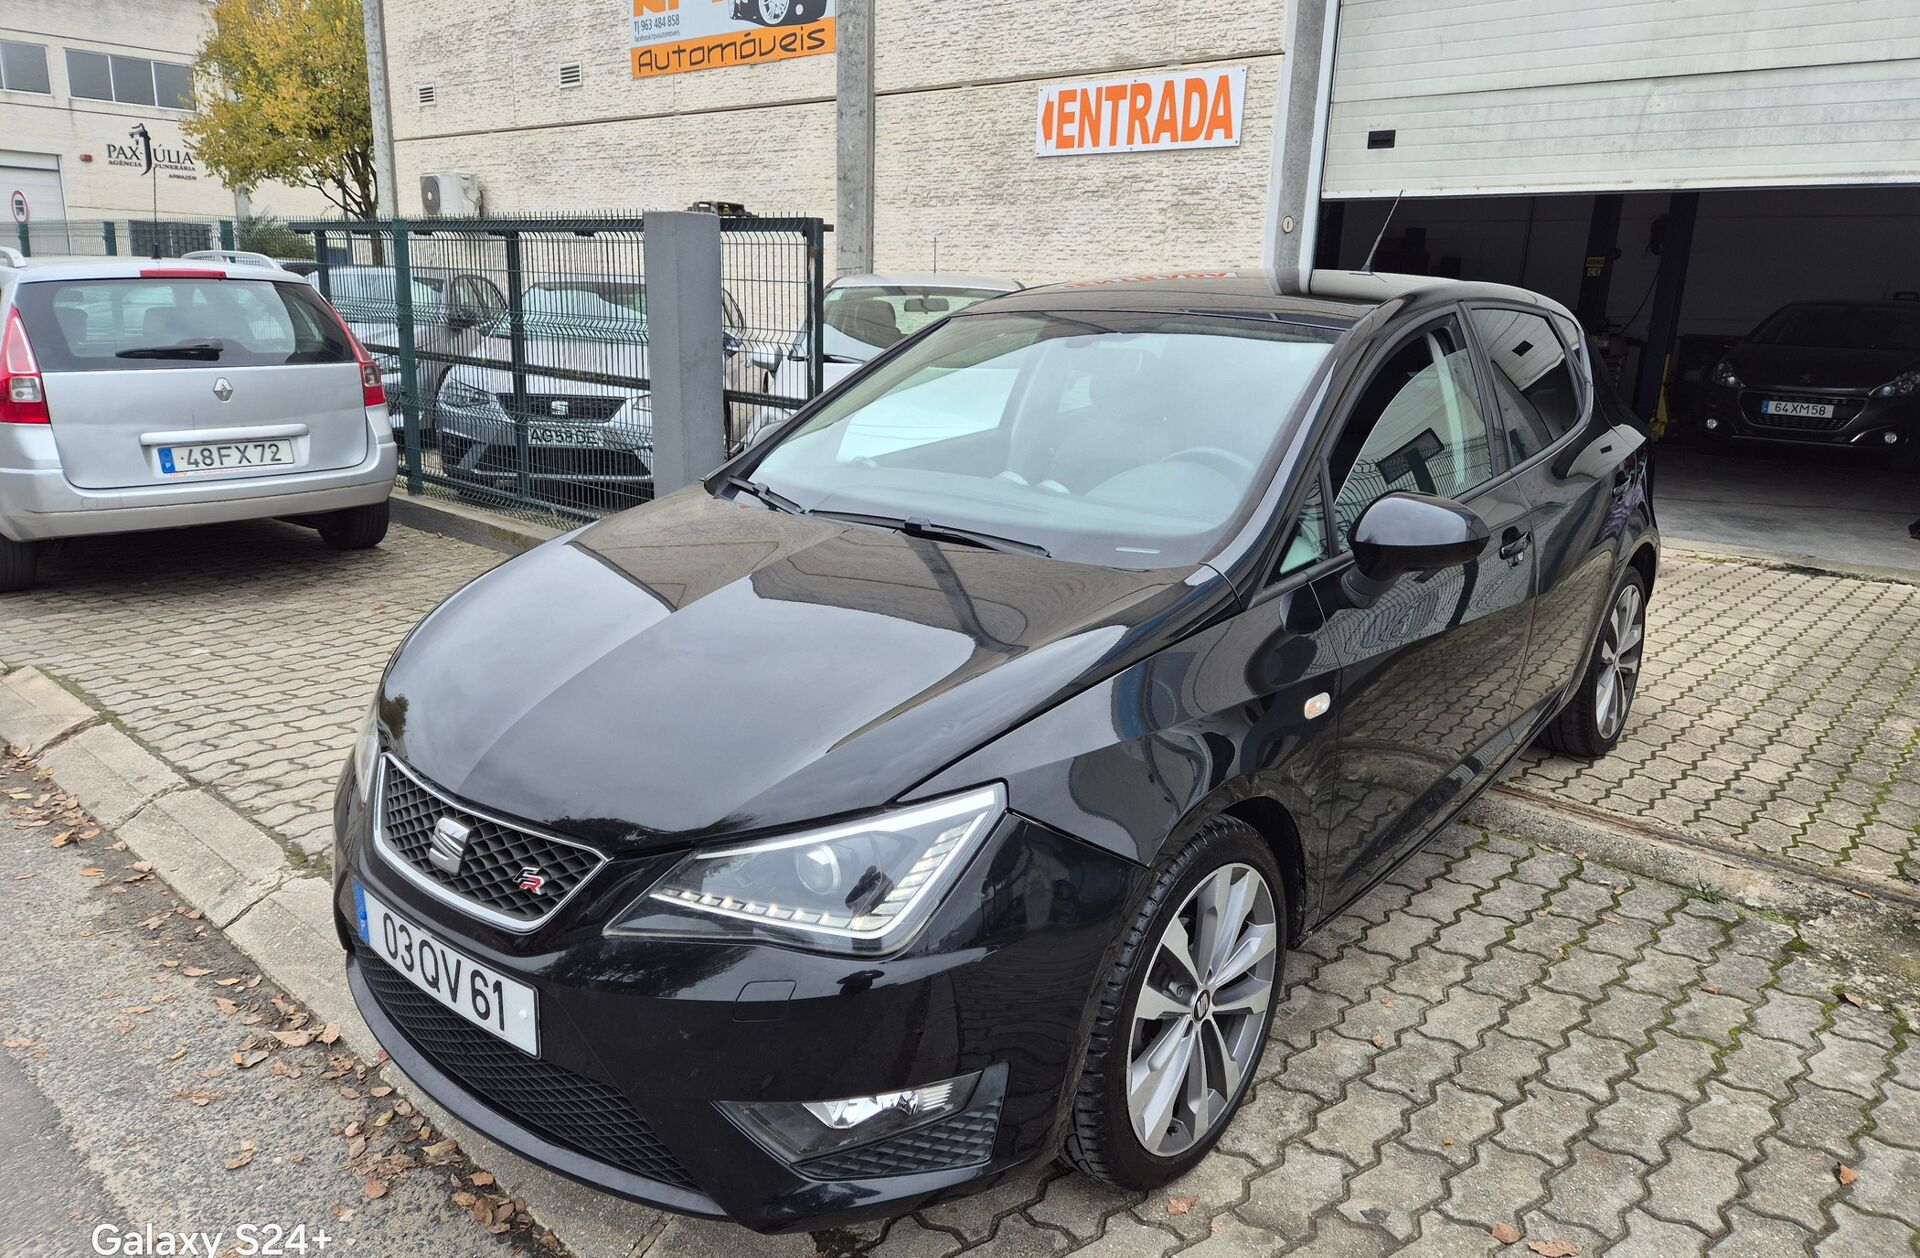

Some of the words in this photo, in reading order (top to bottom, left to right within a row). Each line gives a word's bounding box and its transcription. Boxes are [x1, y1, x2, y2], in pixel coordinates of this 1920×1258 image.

[640, 18, 652, 31] 963
[654, 16, 666, 29] 484
[667, 13, 680, 27] 858
[638, 26, 826, 73] Automóveis
[1055, 74, 1233, 149] ENTRADA
[106, 143, 141, 161] PAX
